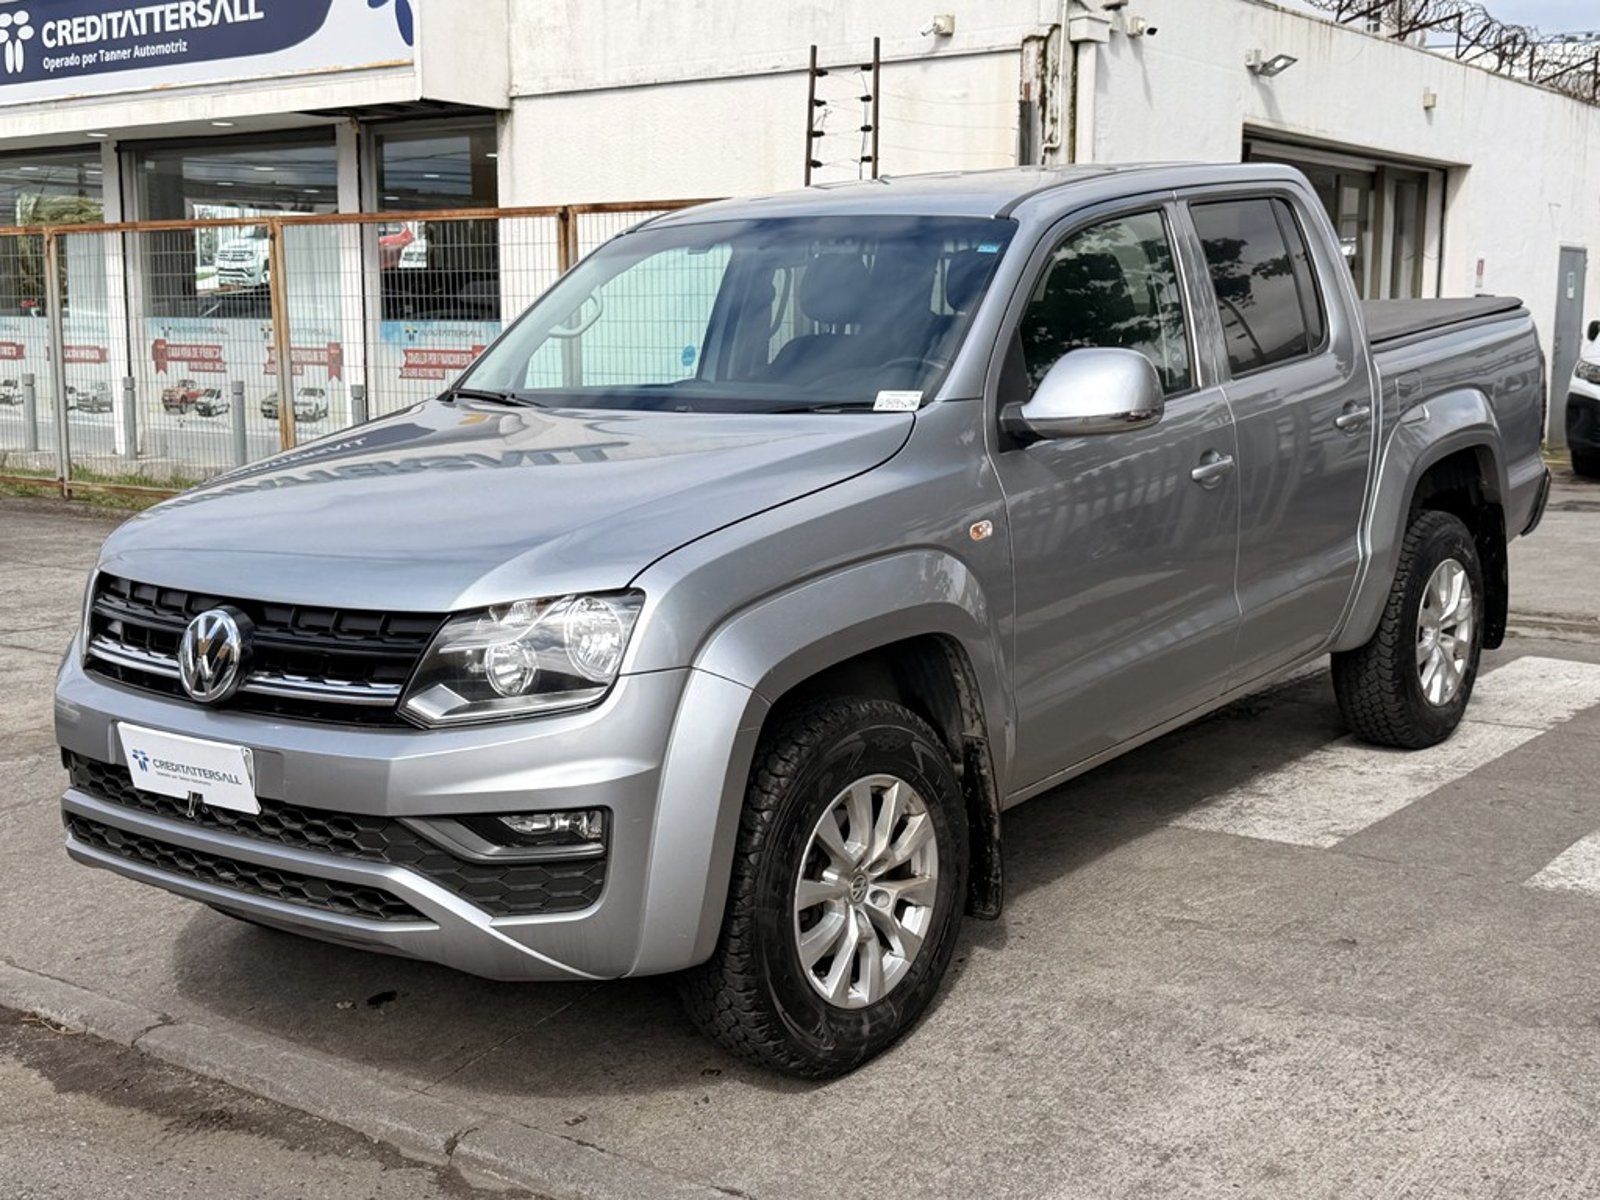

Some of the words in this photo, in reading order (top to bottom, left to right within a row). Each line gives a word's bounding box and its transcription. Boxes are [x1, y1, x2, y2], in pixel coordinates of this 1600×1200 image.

[42, 0, 264, 48] CREDITATTERSALL
[43, 53, 80, 72] Operado
[82, 53, 98, 68] por
[98, 48, 132, 62] Tanner
[133, 39, 188, 58] Automotriz
[152, 758, 242, 785] CREDITATTERSALL
